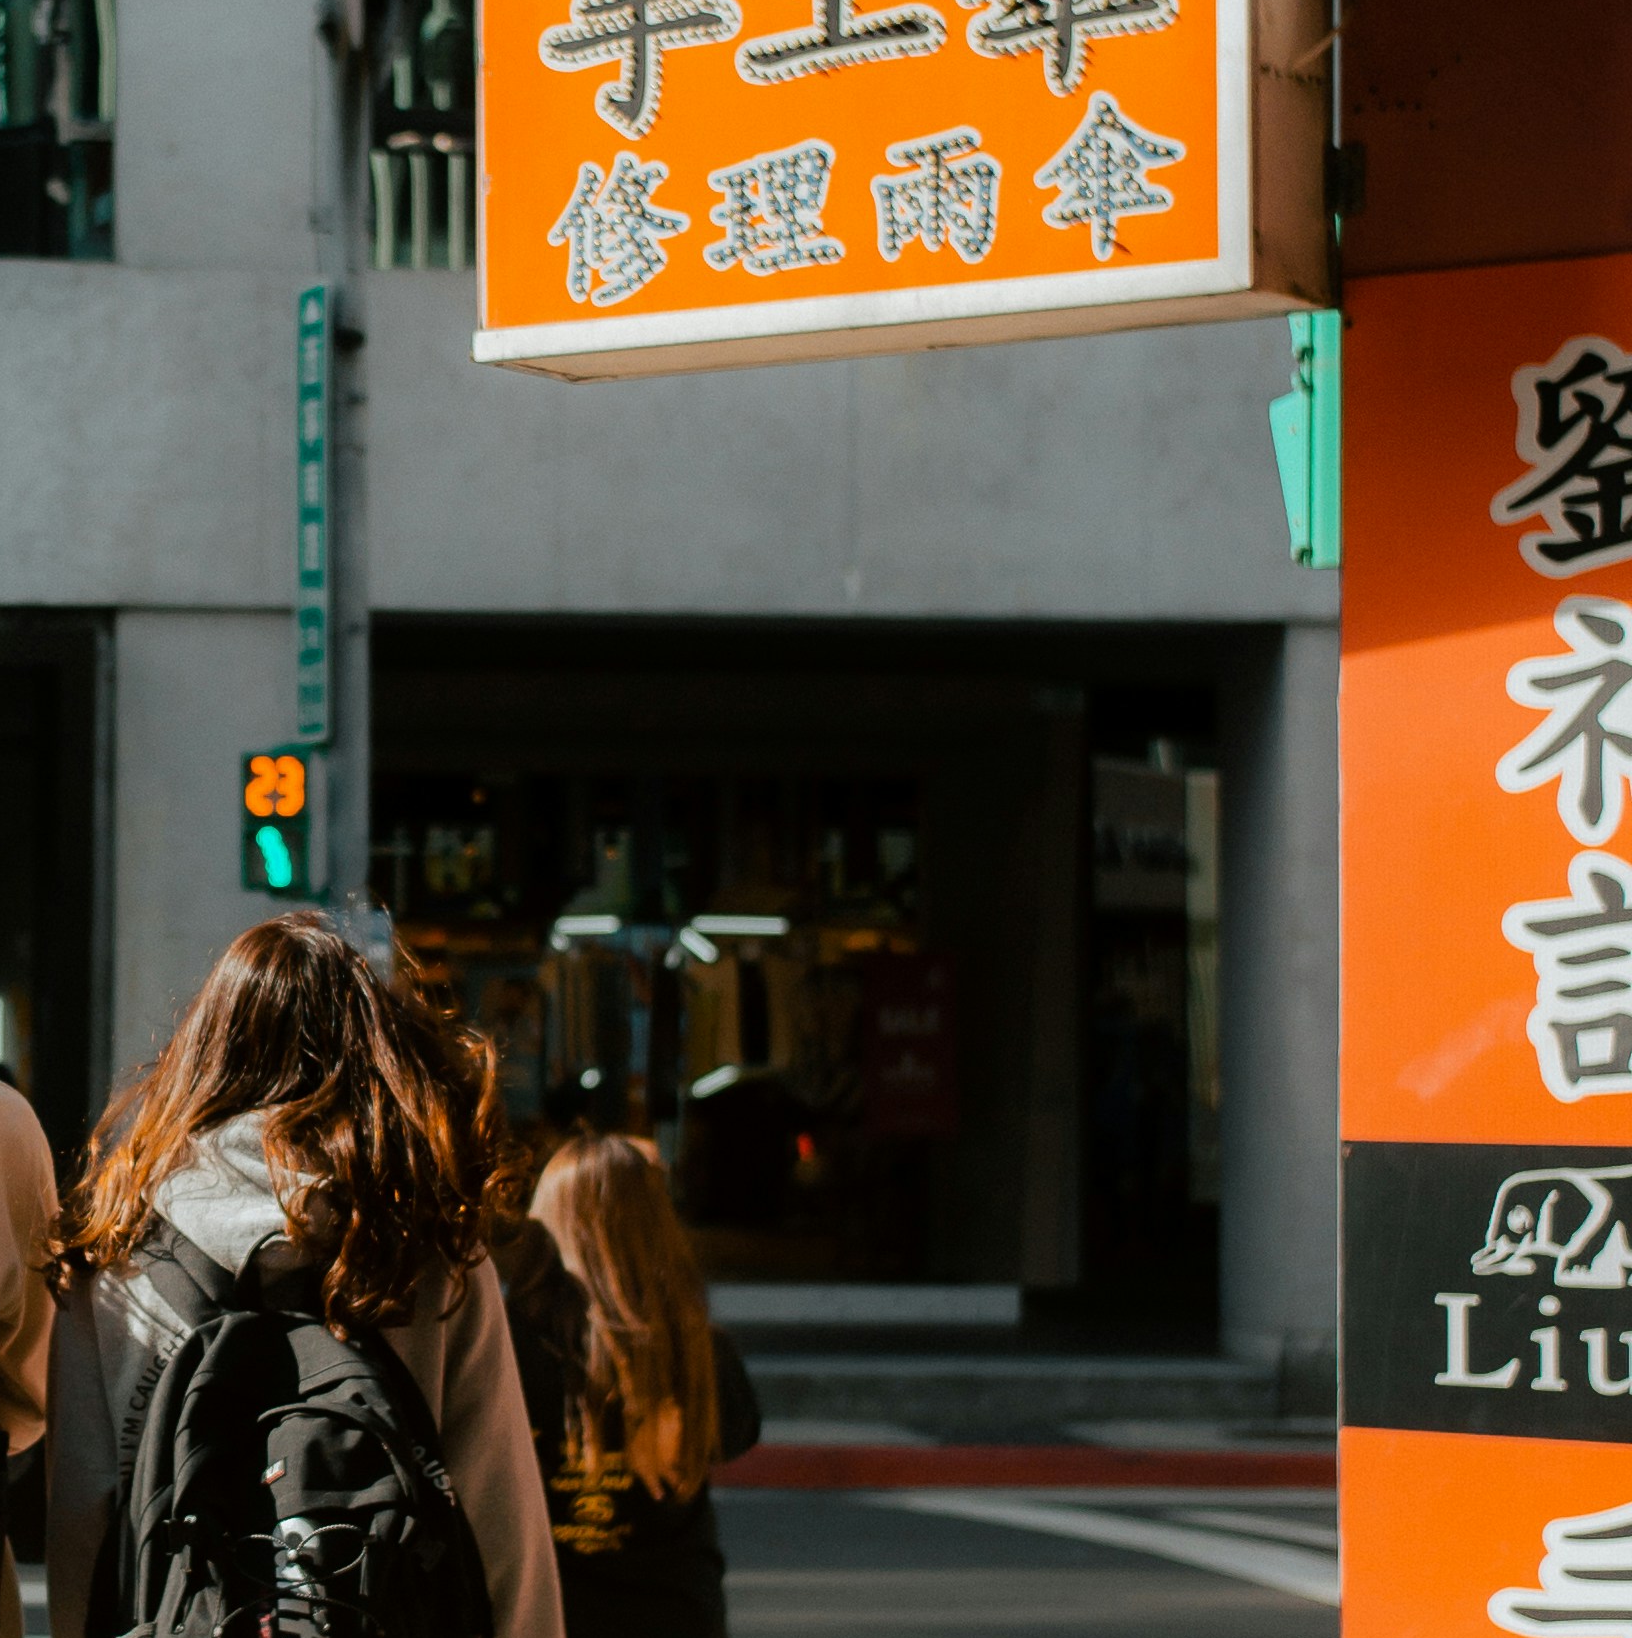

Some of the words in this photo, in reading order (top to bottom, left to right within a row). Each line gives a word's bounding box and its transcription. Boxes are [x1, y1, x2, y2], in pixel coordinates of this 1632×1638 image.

[548, 92, 1187, 307] 修理雨傘
[245, 755, 305, 817] 23
[129, 1329, 187, 1412] CAUGHT
[1434, 1292, 1632, 1397] Liu
[121, 1416, 141, 1450] I'M
